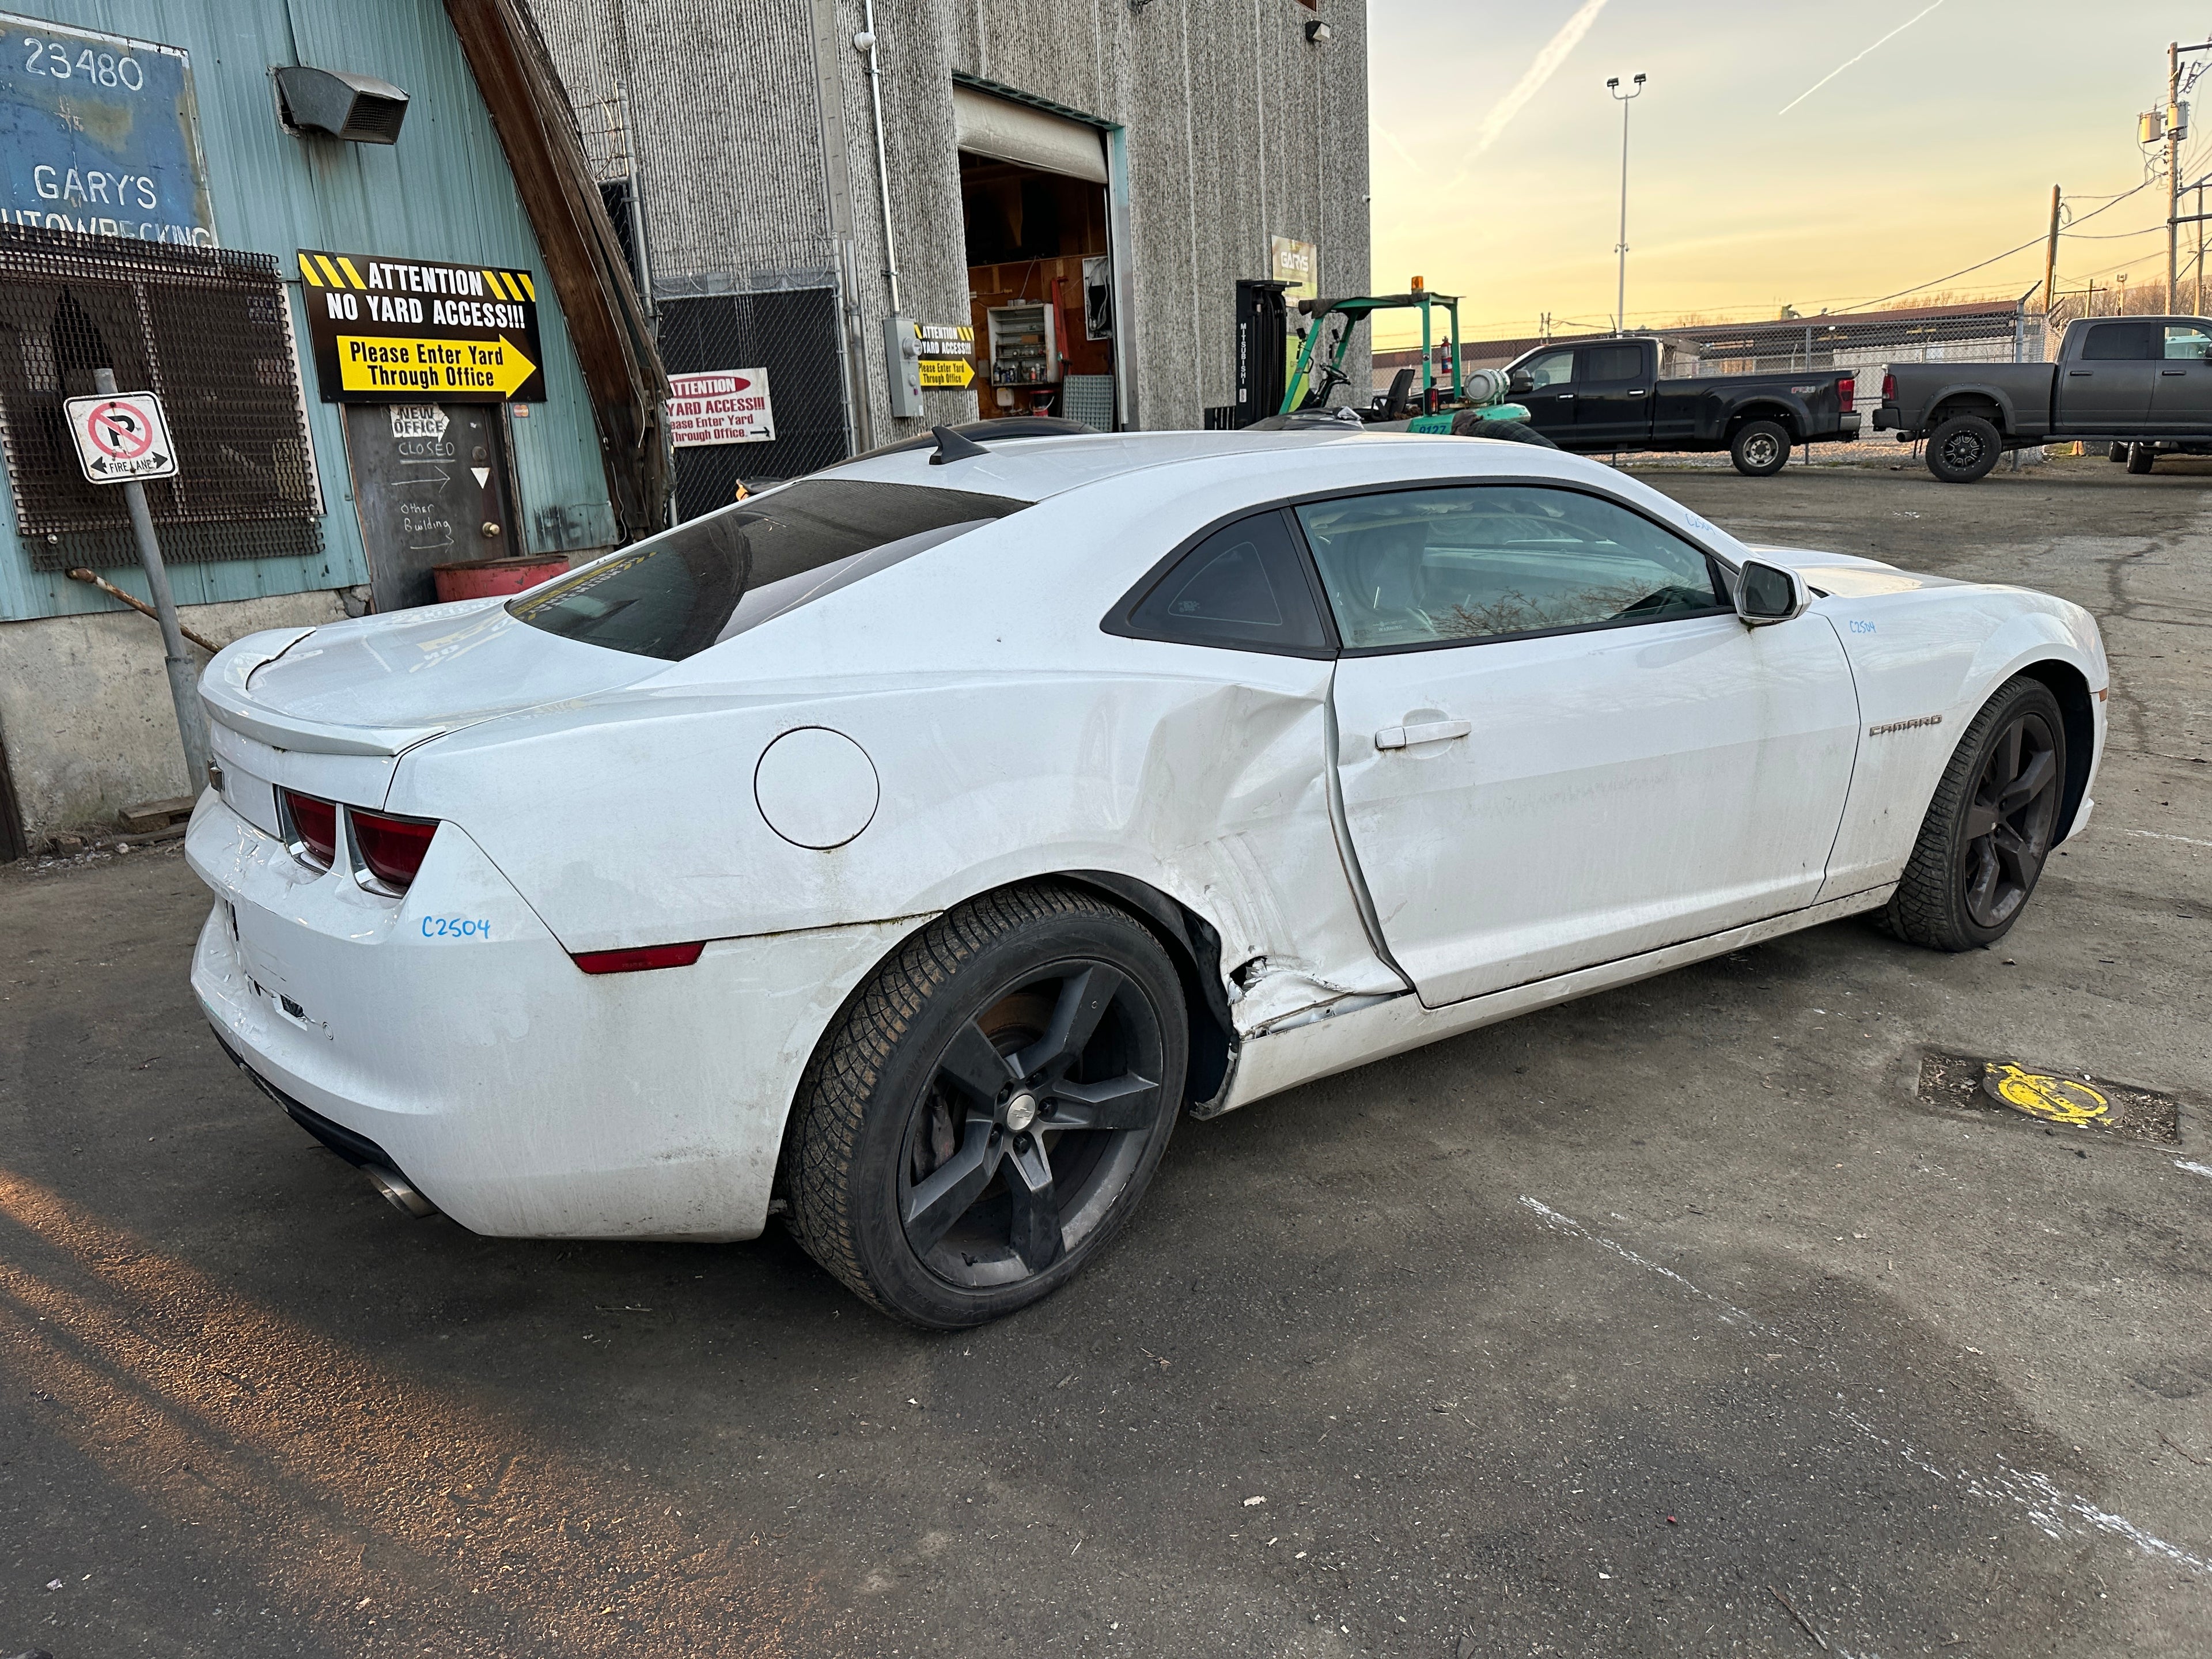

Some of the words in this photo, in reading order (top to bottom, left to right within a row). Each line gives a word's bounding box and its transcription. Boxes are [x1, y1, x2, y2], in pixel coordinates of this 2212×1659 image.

[24, 37, 143, 91] 23480
[33, 164, 157, 210] GARY'S
[1, 208, 214, 251] UTOWRECKING
[369, 262, 484, 297] ATTENTION
[326, 292, 358, 320] NO
[365, 294, 423, 323] YARD
[433, 299, 525, 329] ACCESS!!!
[922, 325, 958, 340] ATTENTION
[350, 340, 409, 363] Please
[417, 343, 461, 365] Enter
[468, 345, 504, 366] Yard
[922, 341, 940, 354] YARD
[942, 342, 972, 355] ACCESS!!!
[937, 363, 951, 373] Enter
[952, 363, 965, 373] Yard
[367, 365, 439, 389] Through
[446, 366, 494, 387] Office
[923, 373, 945, 385] Through
[946, 374, 962, 384] Office
[400, 406, 433, 419] NEW
[668, 402, 702, 416] YARD
[706, 397, 766, 414] ACCESS!!!
[394, 419, 444, 434] OFFICE
[671, 420, 694, 430] ease
[696, 416, 724, 427] Enter
[728, 414, 753, 426] Yard
[672, 430, 711, 442] Through
[399, 441, 454, 456] CLOSED
[109, 461, 130, 473] FIRE
[130, 459, 153, 471] LANE
[404, 517, 452, 535] Building
[1849, 620, 1876, 634] C2504
[1869, 714, 1942, 737] CAMARO
[422, 915, 491, 940] C2504
